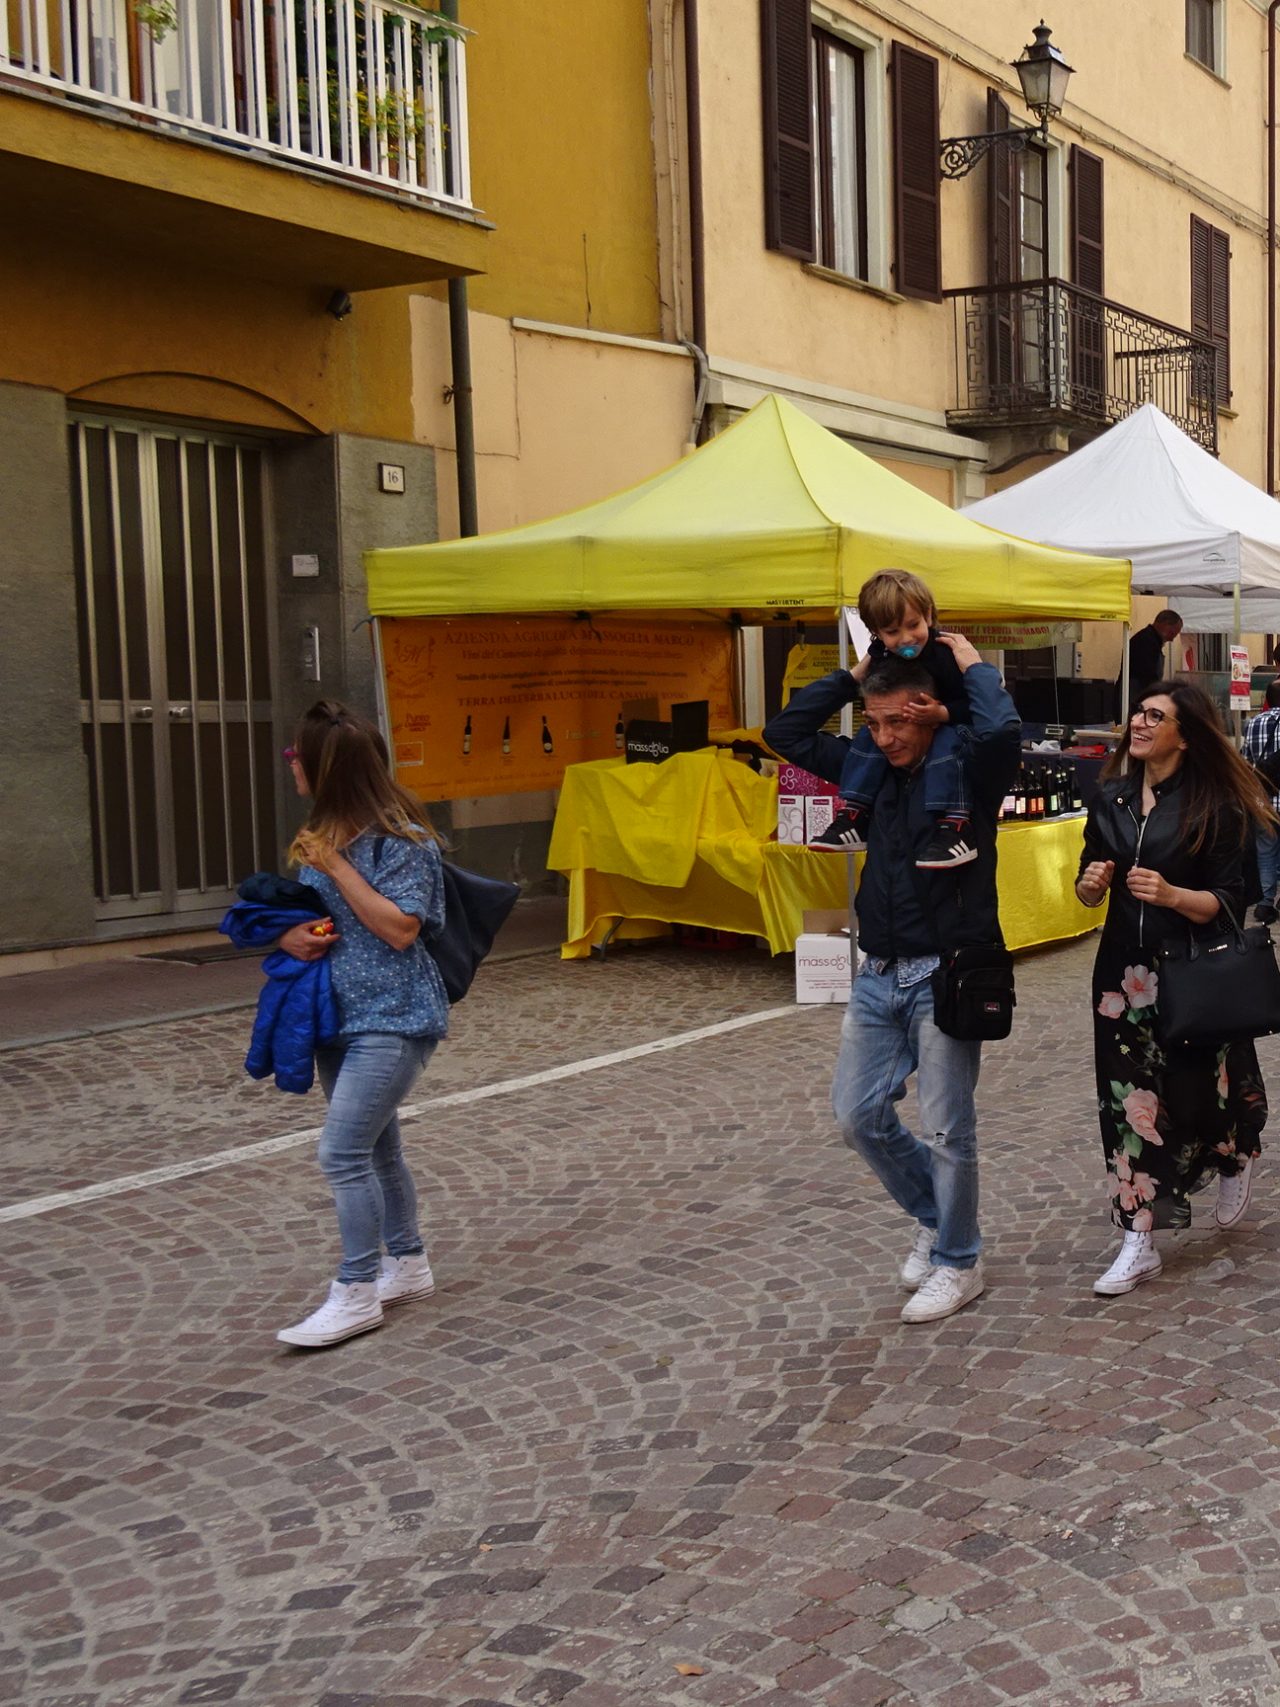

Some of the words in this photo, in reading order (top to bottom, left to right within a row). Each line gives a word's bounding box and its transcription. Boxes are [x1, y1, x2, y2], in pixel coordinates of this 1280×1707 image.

[388, 470, 399, 484] 16
[444, 631, 511, 644] AZIENDA
[653, 632, 695, 646] MARCO
[457, 696, 495, 706] TERRA
